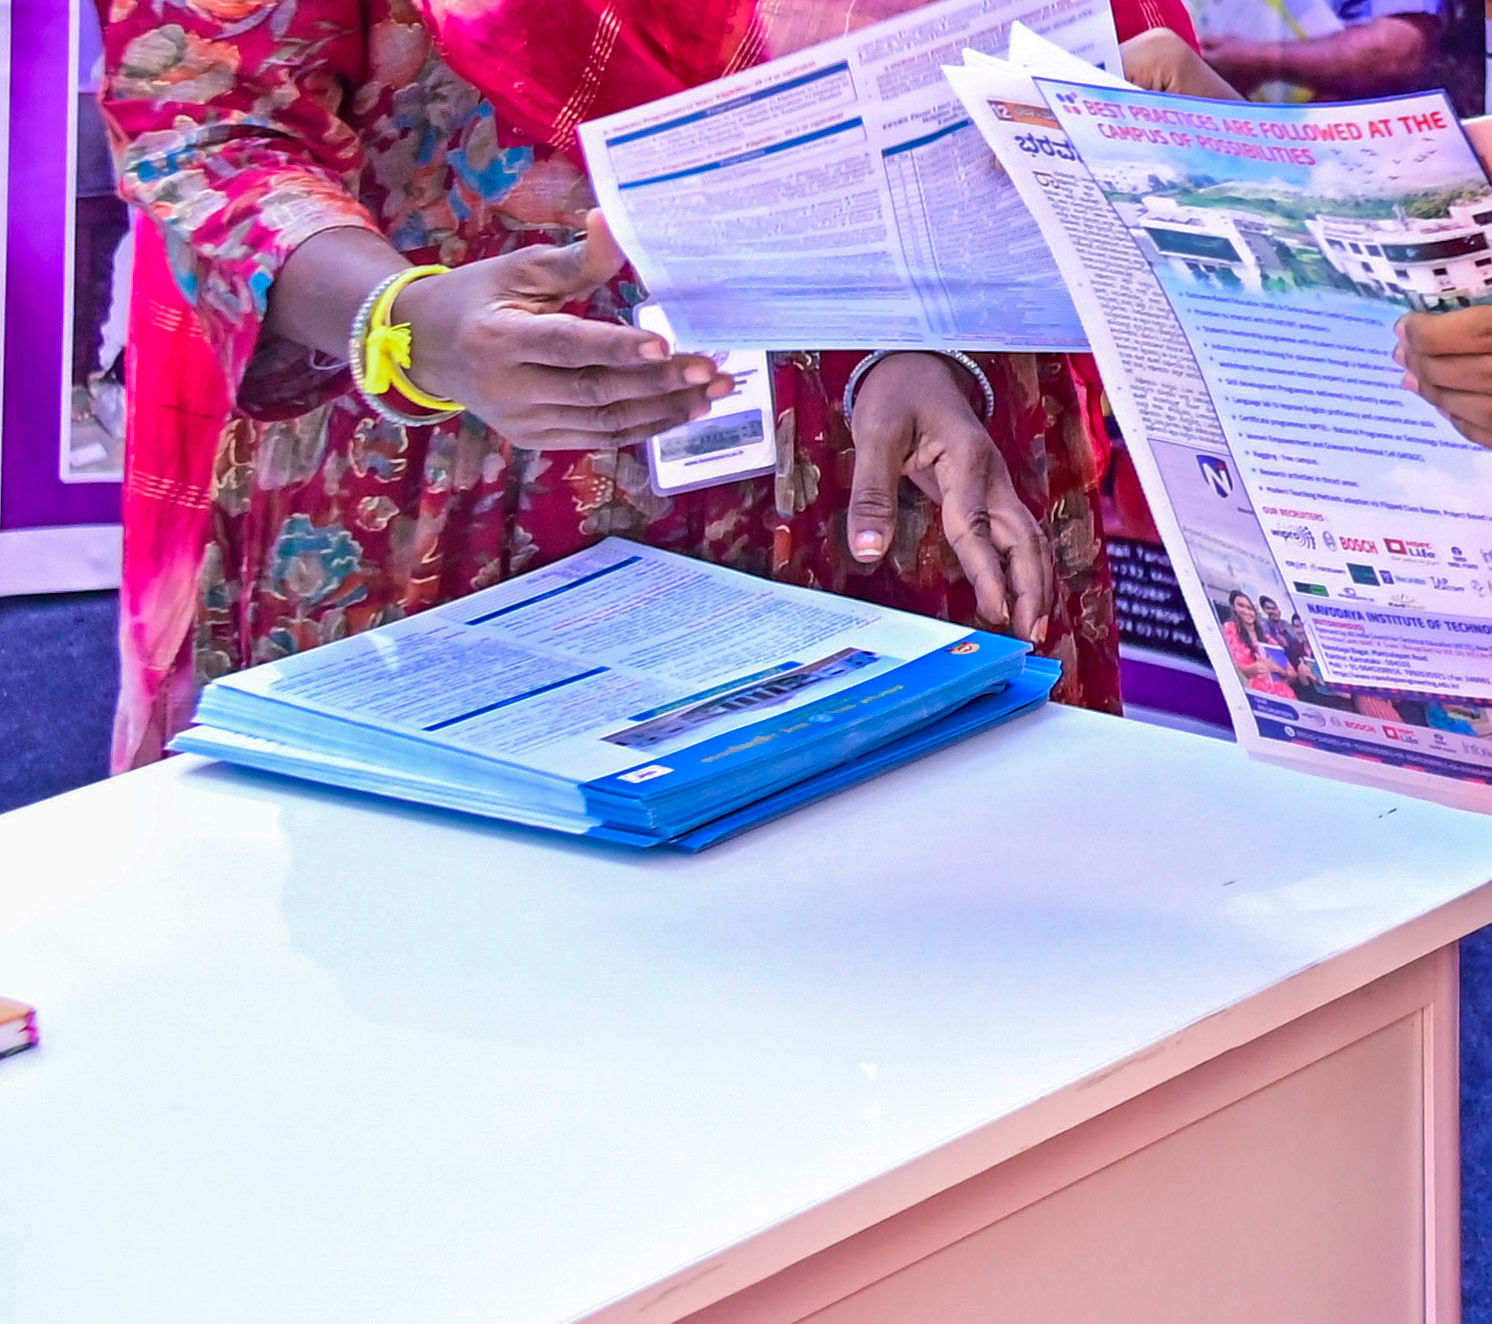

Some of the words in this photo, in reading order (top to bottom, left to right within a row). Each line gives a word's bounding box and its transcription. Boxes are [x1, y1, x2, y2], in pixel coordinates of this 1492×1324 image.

[1082, 99, 1126, 120] BEST
[1128, 104, 1220, 133] PRACTICES
[1222, 118, 1256, 139] ARE
[1260, 121, 1362, 143] FOLLOWED
[1367, 119, 1394, 138] AT
[1397, 111, 1448, 135] THE
[1098, 122, 1168, 147] CAMPUS
[1171, 129, 1192, 148] OF
[1196, 133, 1317, 167] POSSIBILITIES
[1306, 603, 1364, 621] NAVODAYA
[1366, 611, 1425, 629] INSTITUTE
[1428, 617, 1441, 630] OF
